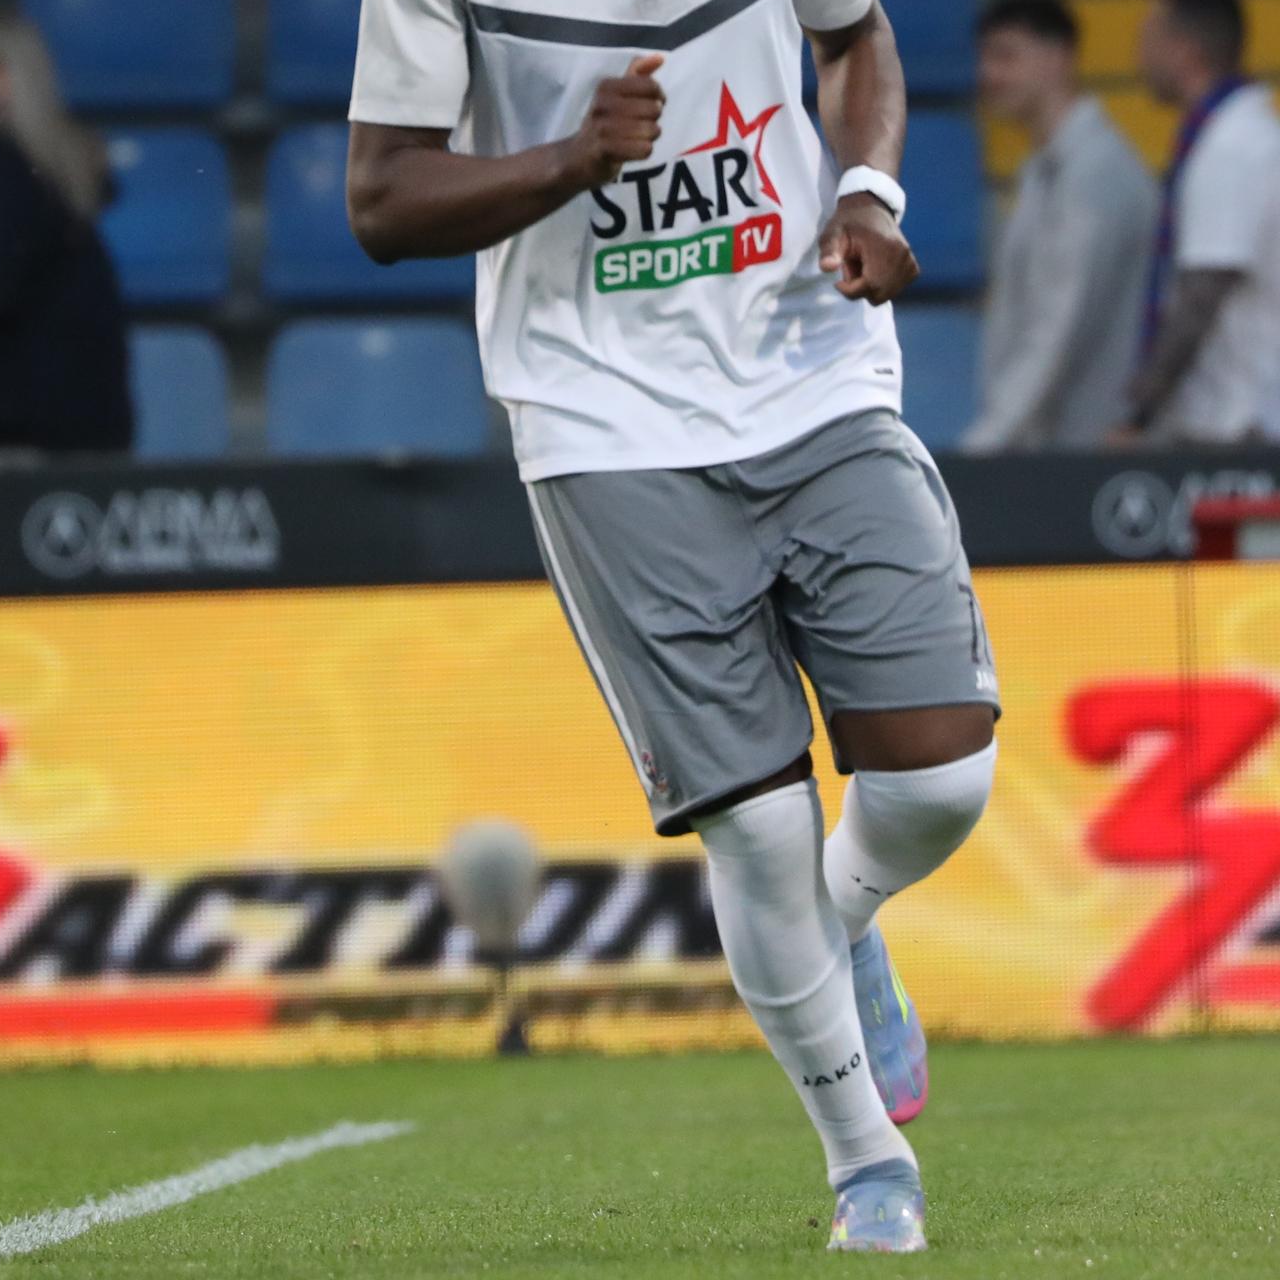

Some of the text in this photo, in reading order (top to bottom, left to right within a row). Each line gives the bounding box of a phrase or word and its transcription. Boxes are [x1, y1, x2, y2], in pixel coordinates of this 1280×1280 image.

[589, 147, 759, 240] STAR
[602, 222, 774, 286] SPORT TV
[802, 1052, 862, 1088] JAKO
